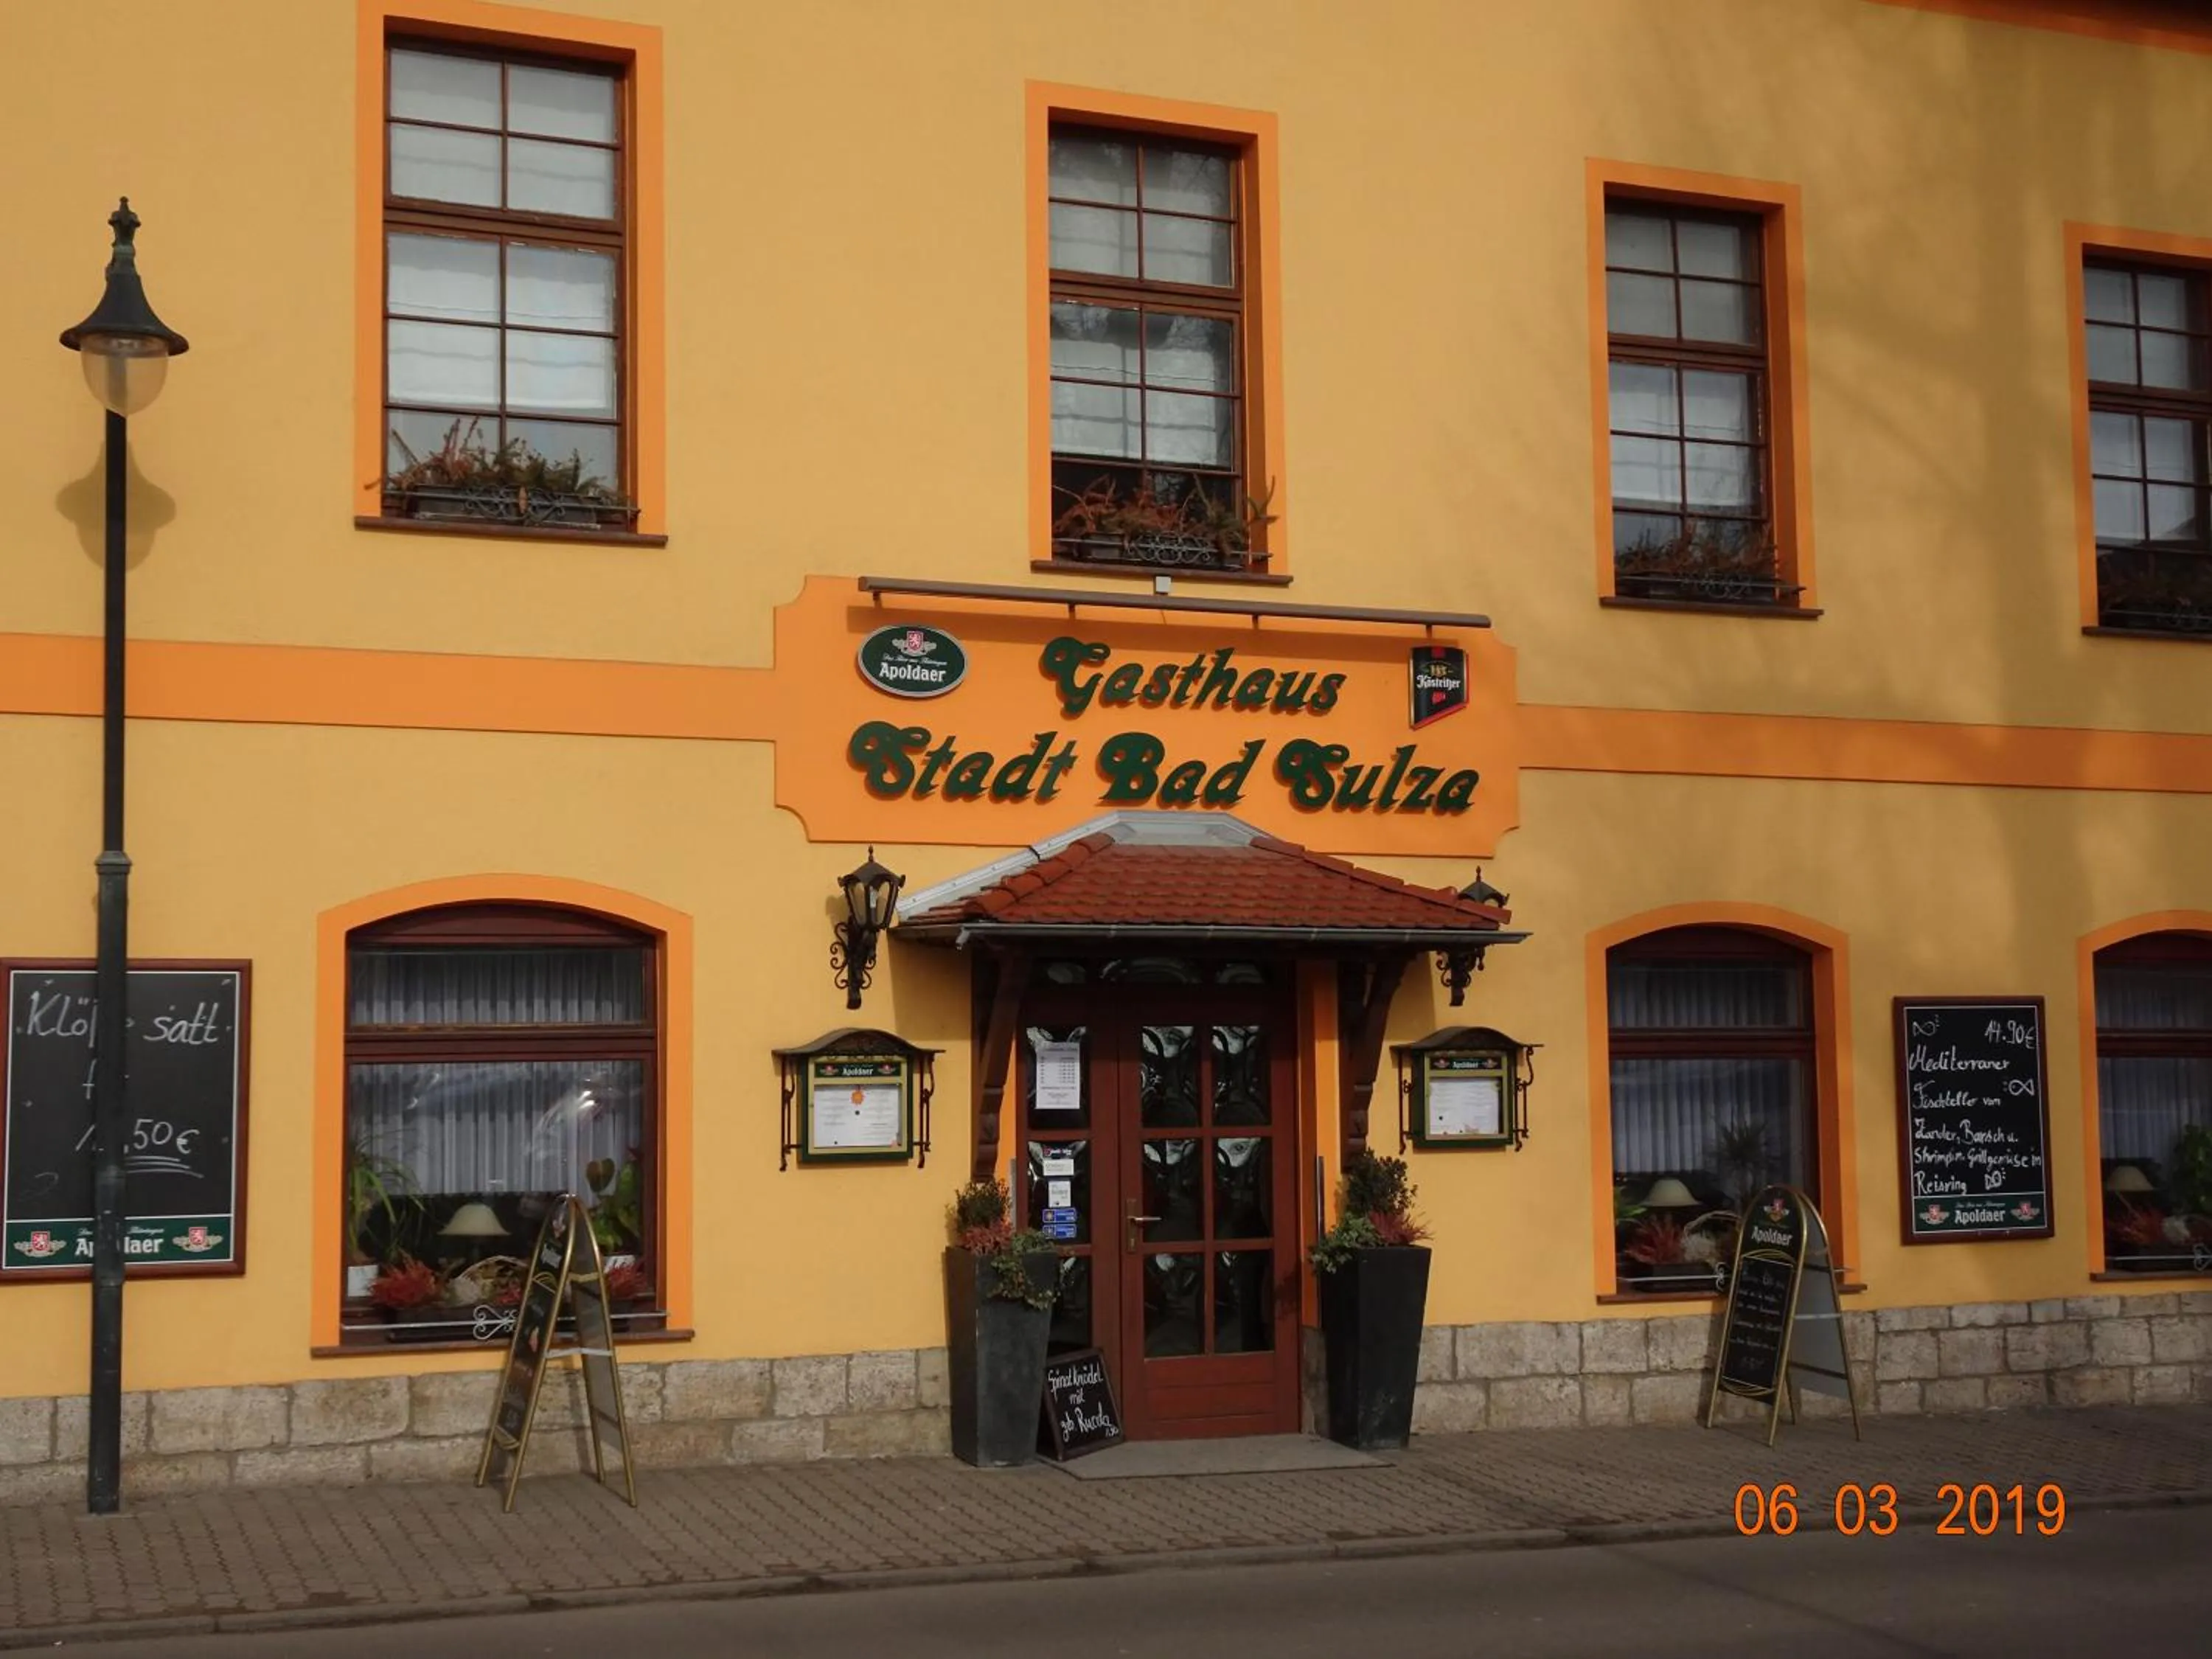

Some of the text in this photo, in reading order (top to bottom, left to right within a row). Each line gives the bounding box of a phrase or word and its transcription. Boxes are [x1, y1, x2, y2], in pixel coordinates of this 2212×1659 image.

[878, 661, 947, 683] Apoldaer
[1043, 636, 1347, 716] Gasthaus
[849, 720, 1480, 810] Stadt Bad Sulza
[1955, 1208, 2006, 1225] Apoldaer
[1751, 1225, 1793, 1246] Apoldaer
